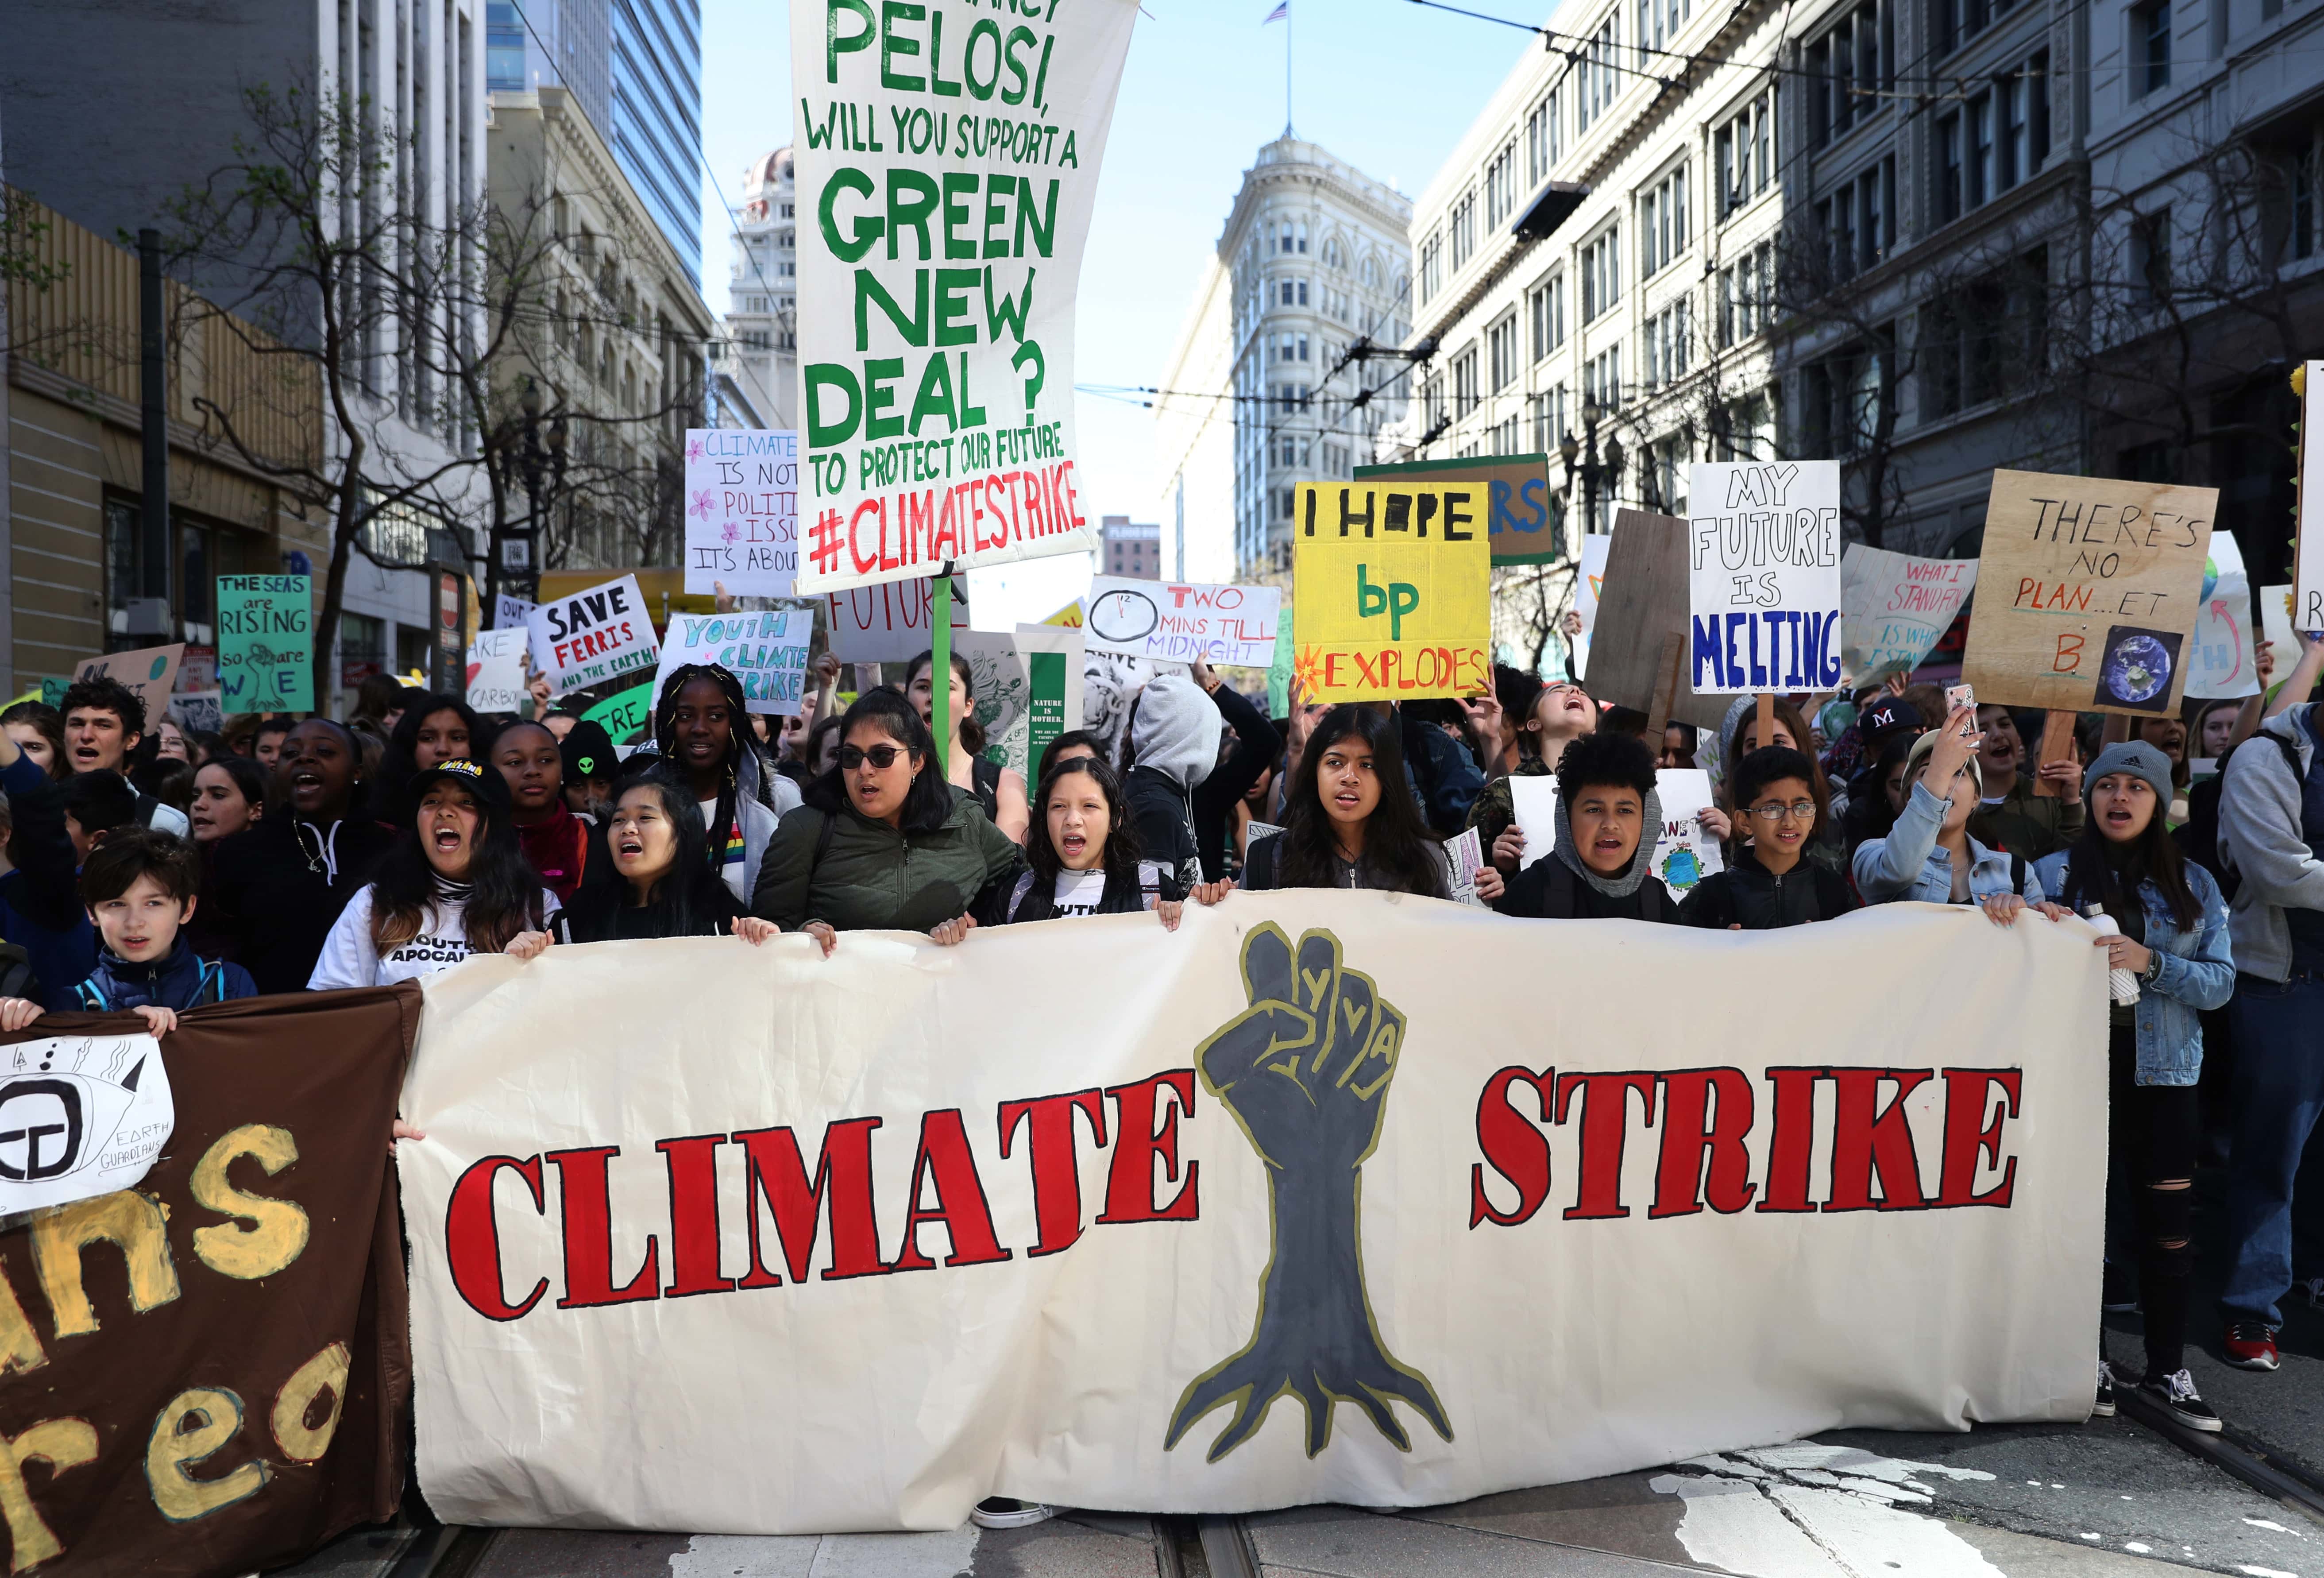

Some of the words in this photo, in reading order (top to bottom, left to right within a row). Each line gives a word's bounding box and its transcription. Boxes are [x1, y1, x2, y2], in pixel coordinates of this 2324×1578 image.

[801, 98, 883, 152] WILL
[891, 106, 947, 156] YOU
[954, 114, 1059, 165] SUPPORT
[1058, 130, 1078, 169] A
[818, 167, 1060, 263] GREEN
[854, 265, 1036, 351] NEW
[706, 433, 797, 456] CLIMATE
[809, 453, 846, 497] TO
[860, 438, 954, 490] PROTECT
[961, 432, 990, 474] OUR
[996, 422, 1064, 468] FUTURE
[715, 461, 744, 484] IS
[758, 463, 797, 485] NOT
[1726, 464, 1799, 509] MY
[809, 460, 1085, 575] #CLIMATESTRIKE
[1305, 489, 1316, 537] I
[1339, 489, 1473, 541] HOPE
[2030, 498, 2206, 547] THERE'S
[1692, 507, 1837, 570] FUTURE
[693, 547, 736, 571] IT'S
[1907, 562, 1950, 582] WHAT
[1948, 564, 1966, 582] I
[2068, 551, 2119, 578] NO
[220, 577, 260, 591] THE
[264, 577, 305, 593] SEAS
[1168, 586, 1244, 610] TWO
[1357, 563, 1419, 641] bp
[1731, 572, 1781, 607] IS
[244, 599, 273, 610] are
[548, 586, 629, 642] SAVE
[220, 610, 306, 634] RISING
[683, 613, 788, 647] YOUTH
[1159, 615, 1208, 634] MINS
[1218, 619, 1276, 641] TILL
[1881, 624, 1903, 645] IS
[277, 651, 305, 663] are
[554, 622, 633, 668] FERRIS
[1146, 636, 1261, 661] MIDNIGHT
[1692, 610, 1841, 689] MELTING
[1865, 649, 1882, 666] I
[2053, 634, 2085, 672] B
[562, 673, 582, 689] AND
[583, 665, 606, 679] THE
[610, 646, 659, 672] EARTH!
[1324, 647, 1487, 691] EXPLODES
[439, 760, 483, 776] OAKLAND
[116, 1122, 169, 1146] EARTH
[100, 1139, 162, 1169] GUARDIANS
[444, 1067, 1201, 1323] CLIMATE
[1469, 1066, 2023, 1230] STRIKE
